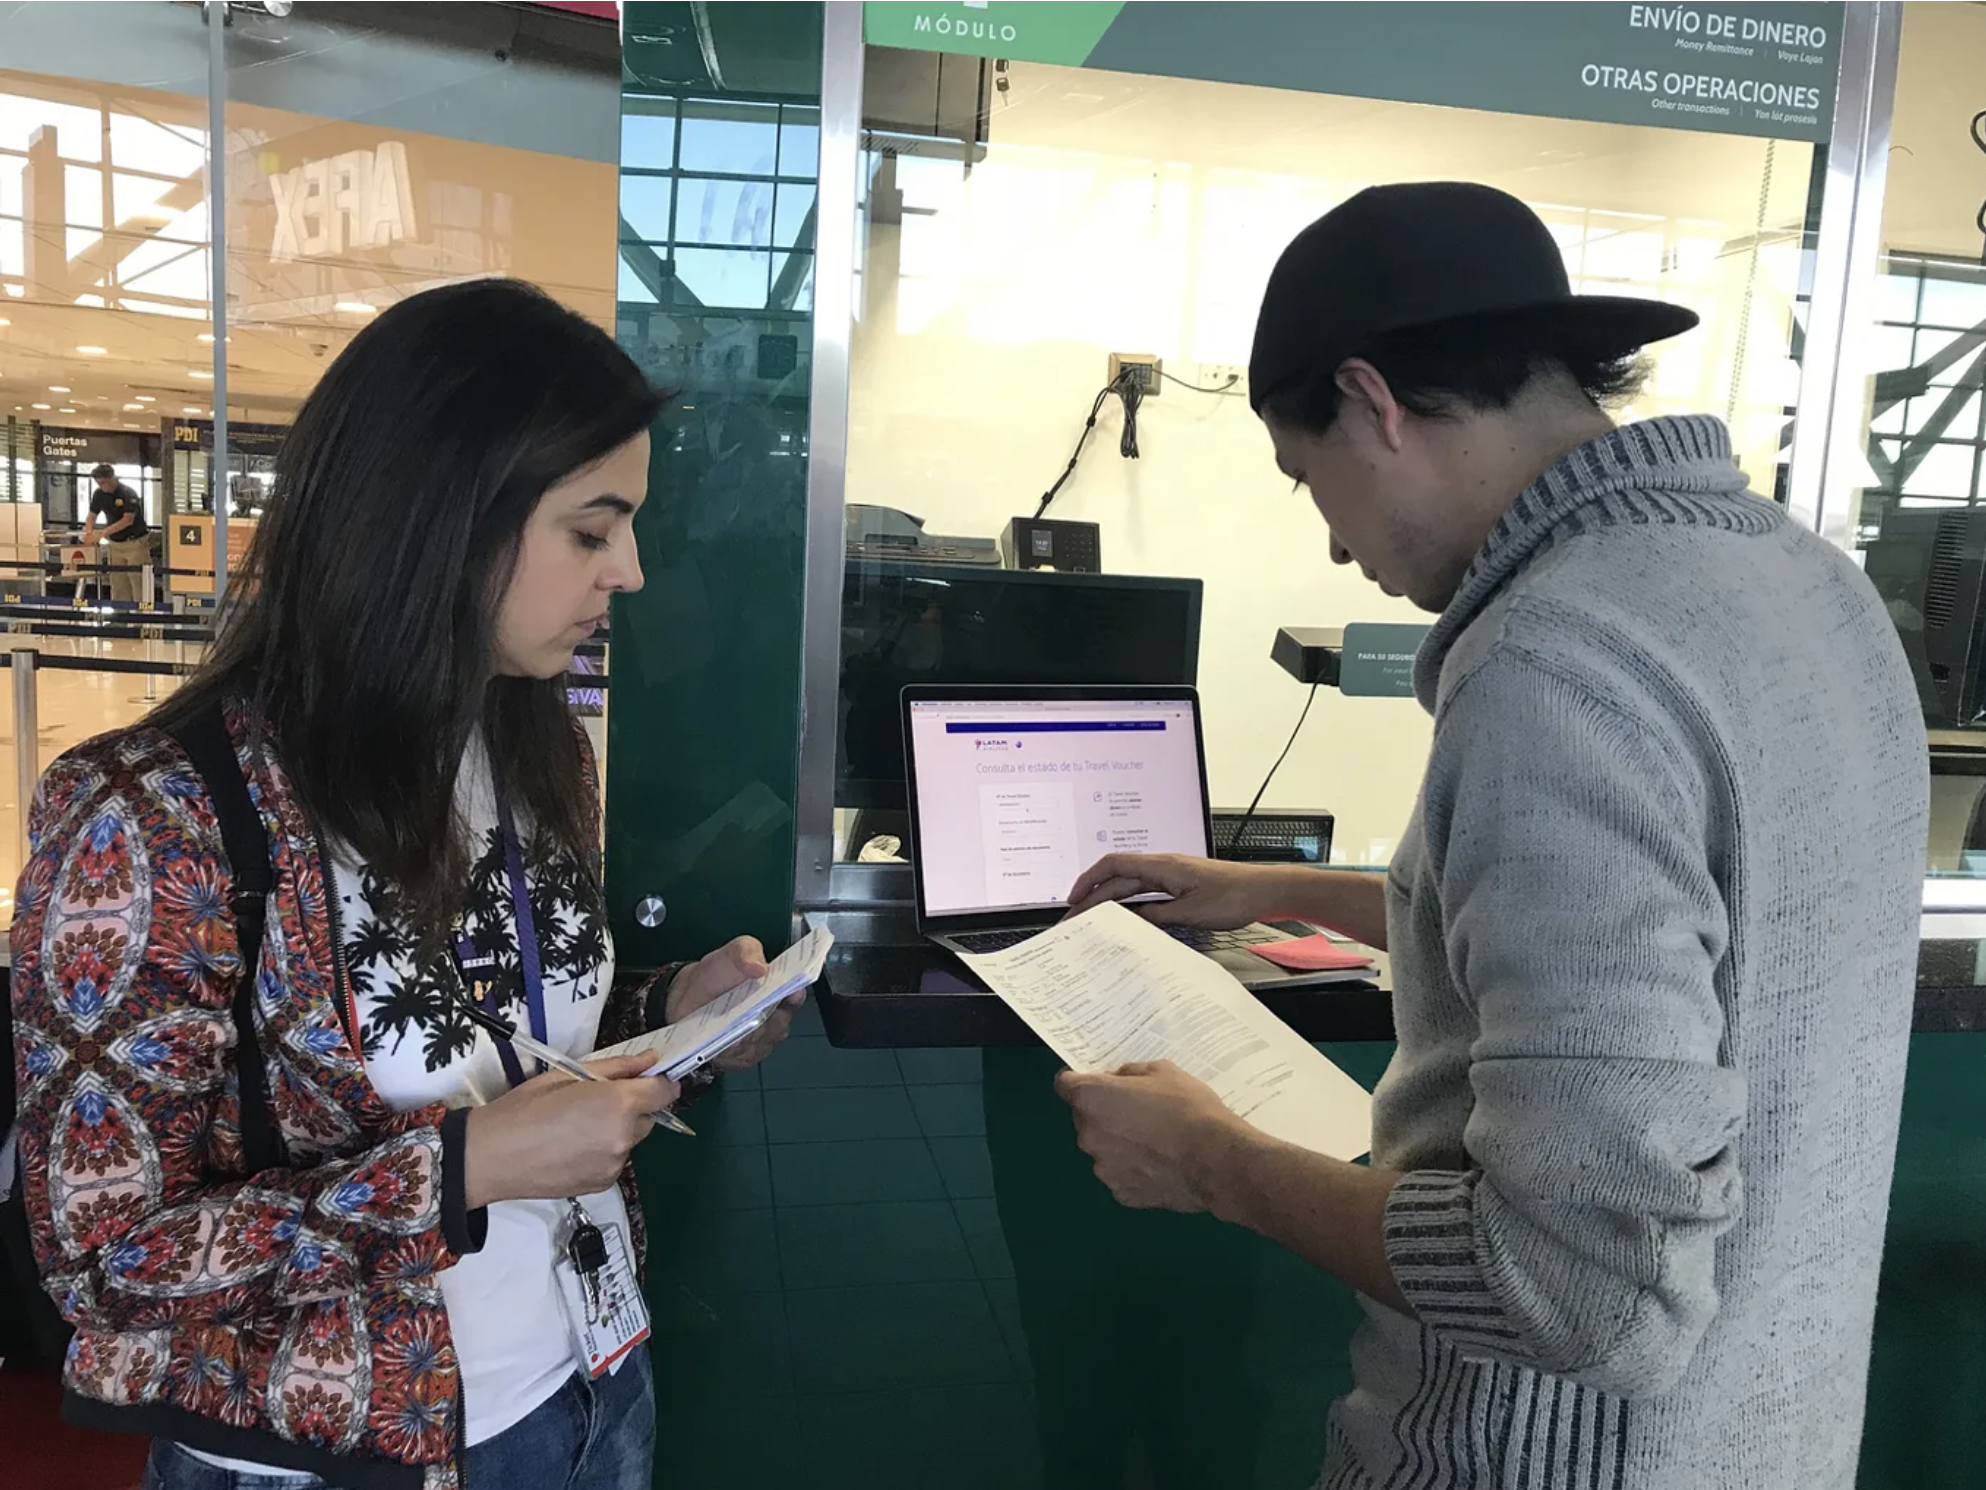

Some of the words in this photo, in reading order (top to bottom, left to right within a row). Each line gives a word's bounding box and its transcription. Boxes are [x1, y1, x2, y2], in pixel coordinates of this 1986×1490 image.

[914, 13, 1017, 41] MÓDULO
[1630, 5, 1700, 33] ENVÍO
[1706, 13, 1737, 38] DE
[1741, 18, 1827, 48] DINERO
[1674, 38, 1704, 52] Money
[1706, 41, 1754, 56] Remittance
[1581, 64, 1658, 93] OTRAS
[1663, 73, 1820, 110] OPERACIONES
[1651, 98, 1676, 110] Other
[1677, 101, 1730, 116] transactions
[42, 434, 88, 447] Puertas
[174, 426, 199, 443] PDI
[43, 445, 77, 457] Gates
[185, 529, 196, 542] 4
[976, 763, 1016, 774] Consulta
[1027, 761, 1058, 773] estado
[1060, 760, 1071, 772] de
[1084, 759, 1109, 771] Travel
[1111, 758, 1144, 771] Voucher
